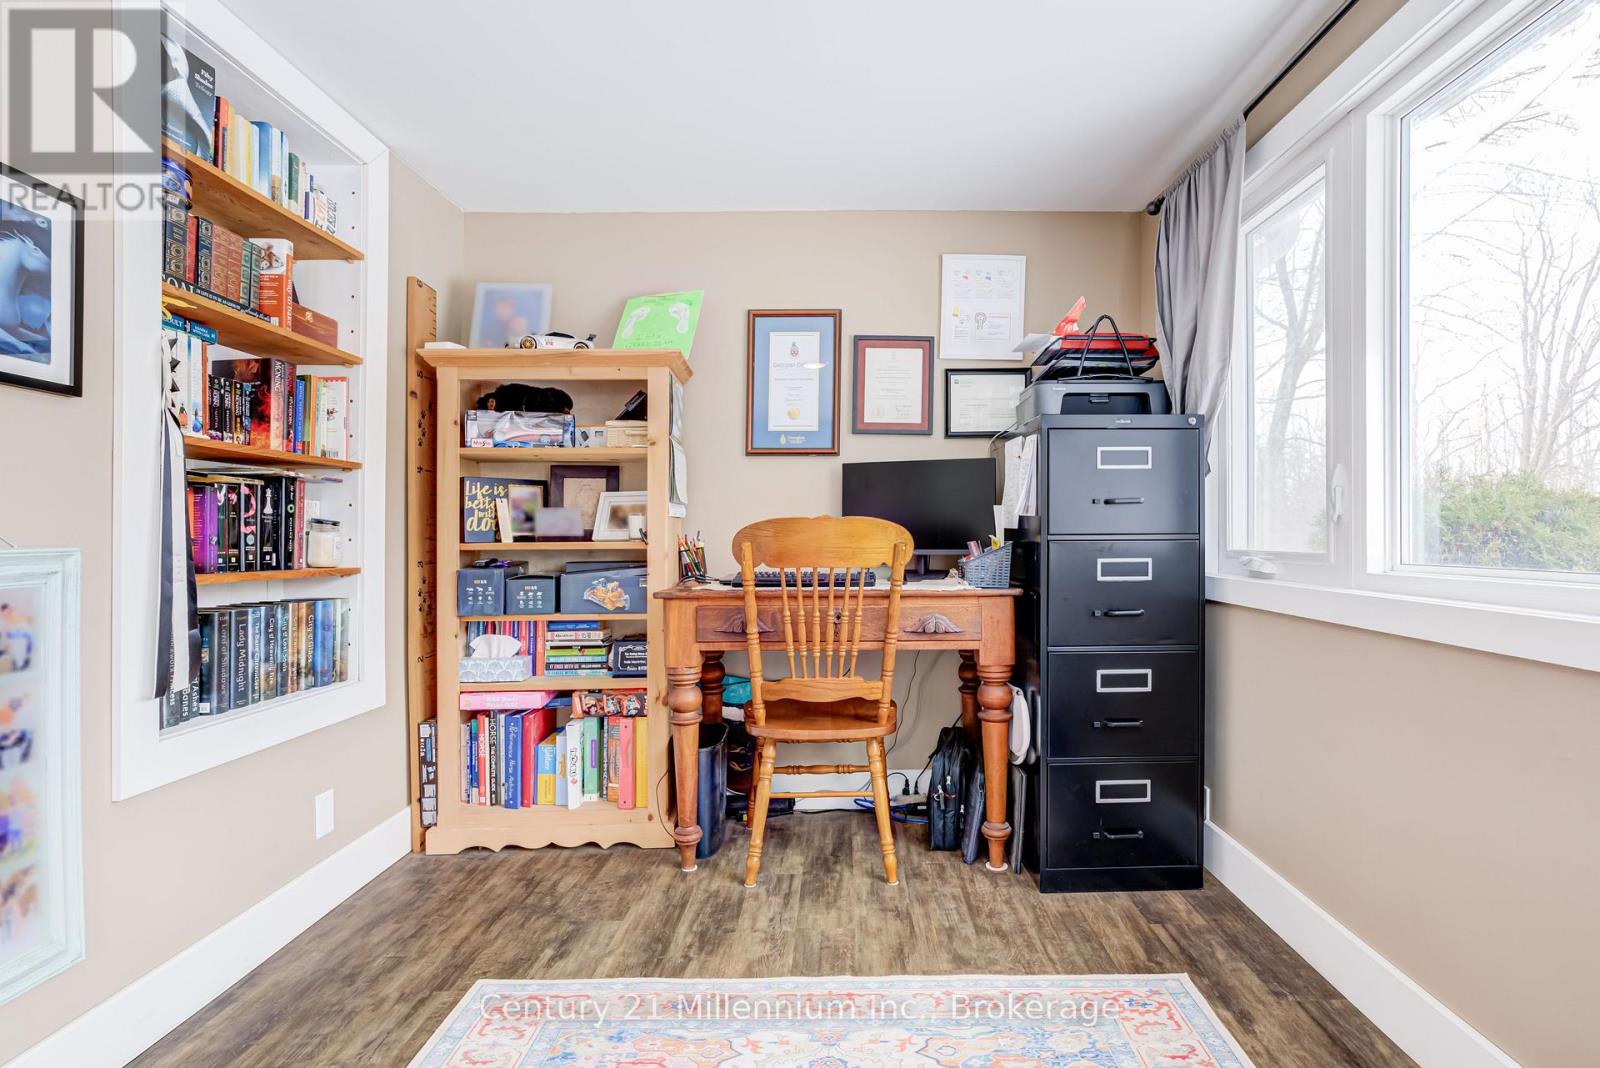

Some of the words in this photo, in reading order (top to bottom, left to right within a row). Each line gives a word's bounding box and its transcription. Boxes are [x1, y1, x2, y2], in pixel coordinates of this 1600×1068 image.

[274, 360, 282, 392] MONING
[417, 370, 424, 380] 5
[417, 465, 424, 473] 4
[465, 480, 493, 499] Life
[493, 483, 508, 497] is
[237, 623, 247, 648] Lady
[236, 649, 247, 693] Midnight
[417, 655, 424, 663] 2
[182, 688, 190, 717] Bones
[489, 718, 497, 744] HORSE
[508, 725, 518, 758] Performance
[508, 759, 517, 774] Horse
